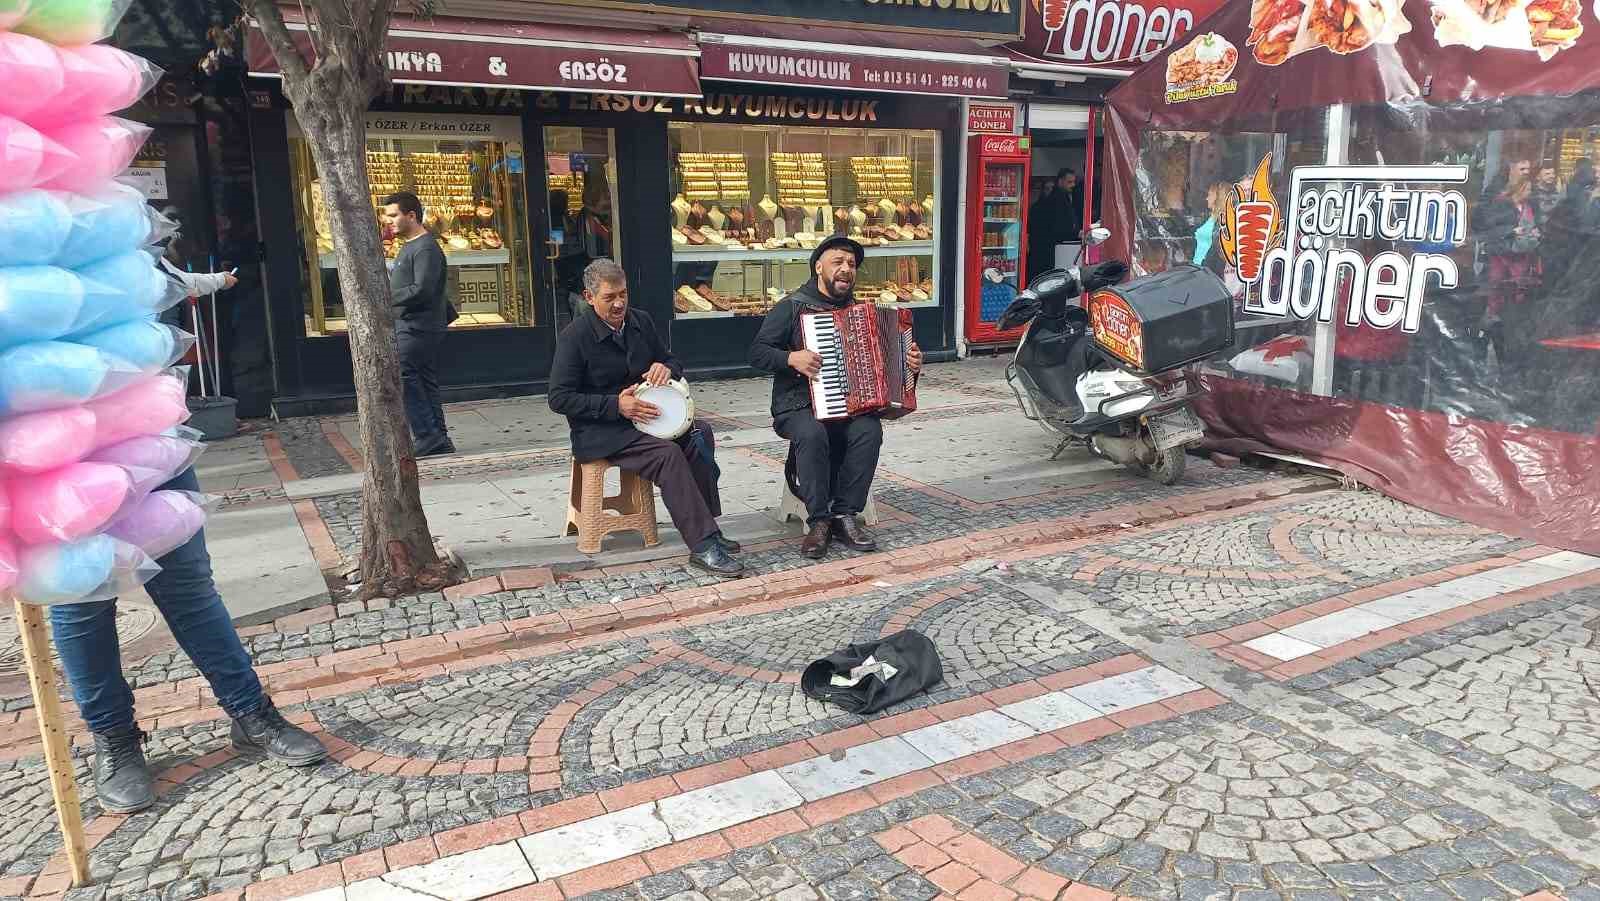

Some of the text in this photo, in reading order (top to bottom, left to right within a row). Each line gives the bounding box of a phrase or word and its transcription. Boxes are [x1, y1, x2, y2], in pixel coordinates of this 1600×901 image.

[488, 56, 508, 77] &
[559, 57, 628, 83] ERSÖZ
[728, 52, 851, 81] KUYUMCULUK
[863, 69, 881, 83] Tel:
[883, 70, 903, 85] 213
[905, 72, 917, 85] 51
[920, 73, 932, 86] 41
[941, 74, 959, 88] 225
[961, 76, 973, 89] 40
[975, 77, 988, 90] 64
[683, 95, 880, 121] KUYUMCULUK
[419, 120, 456, 132] Erkan
[973, 119, 1007, 130] DÖNER
[1258, 234, 1460, 333] döner
